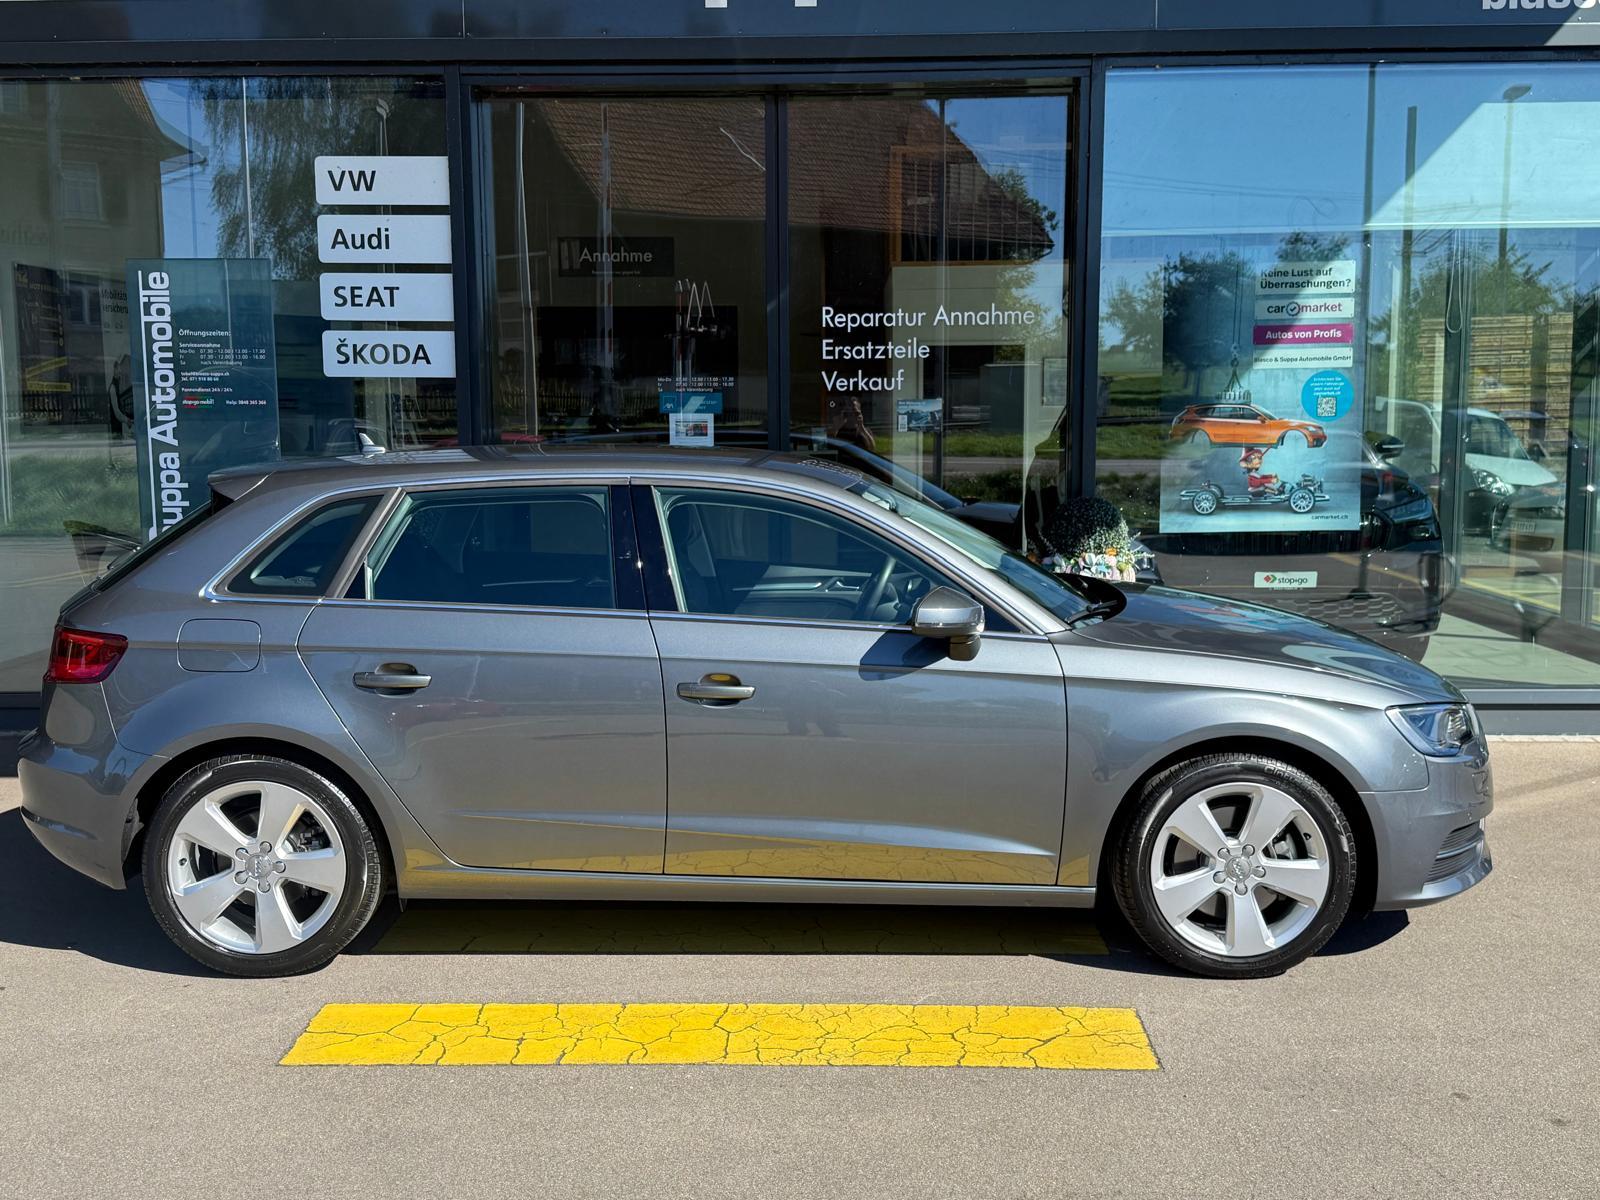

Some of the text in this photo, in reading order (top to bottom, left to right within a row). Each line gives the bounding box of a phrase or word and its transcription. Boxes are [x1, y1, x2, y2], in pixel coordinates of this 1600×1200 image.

[327, 170, 376, 192] VW
[330, 227, 390, 250] Audi
[580, 246, 653, 262] Annahme
[1261, 268, 1333, 278] Keine Lust auf
[1260, 279, 1352, 290] Überraschungen?
[333, 286, 400, 308] SEAT
[821, 303, 1036, 332] Reparatur Annahme
[178, 329, 232, 337] Öffnungszeiten:
[1314, 329, 1342, 337] Profis
[336, 337, 431, 365] ŠKODA
[821, 337, 931, 360] Ersatzteile
[821, 370, 905, 391] Verkauf
[138, 270, 190, 541] uppa Automobile
